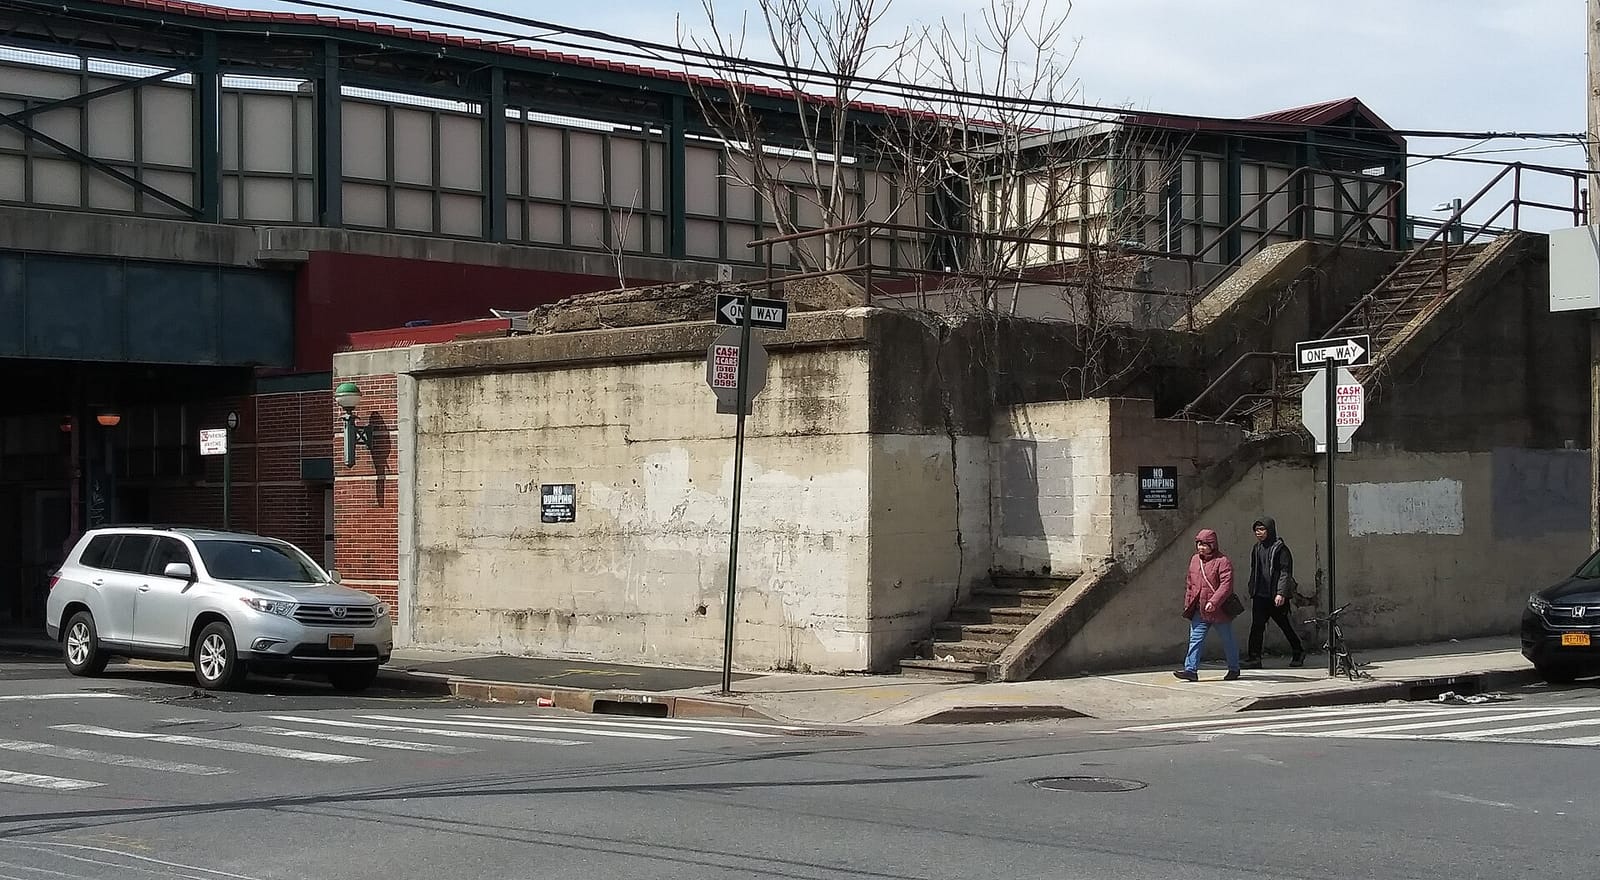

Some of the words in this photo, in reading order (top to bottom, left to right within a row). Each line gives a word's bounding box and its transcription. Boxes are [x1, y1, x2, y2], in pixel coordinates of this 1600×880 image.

[729, 304, 744, 317] ON
[757, 307, 779, 321] WAY
[1307, 349, 1327, 362] ONE
[1335, 346, 1358, 359] WAY
[717, 372, 735, 380] 636
[1153, 468, 1163, 478] NO
[1142, 478, 1175, 489] DUMPING
[552, 485, 563, 495] NO
[543, 494, 573, 504] DUMPING
